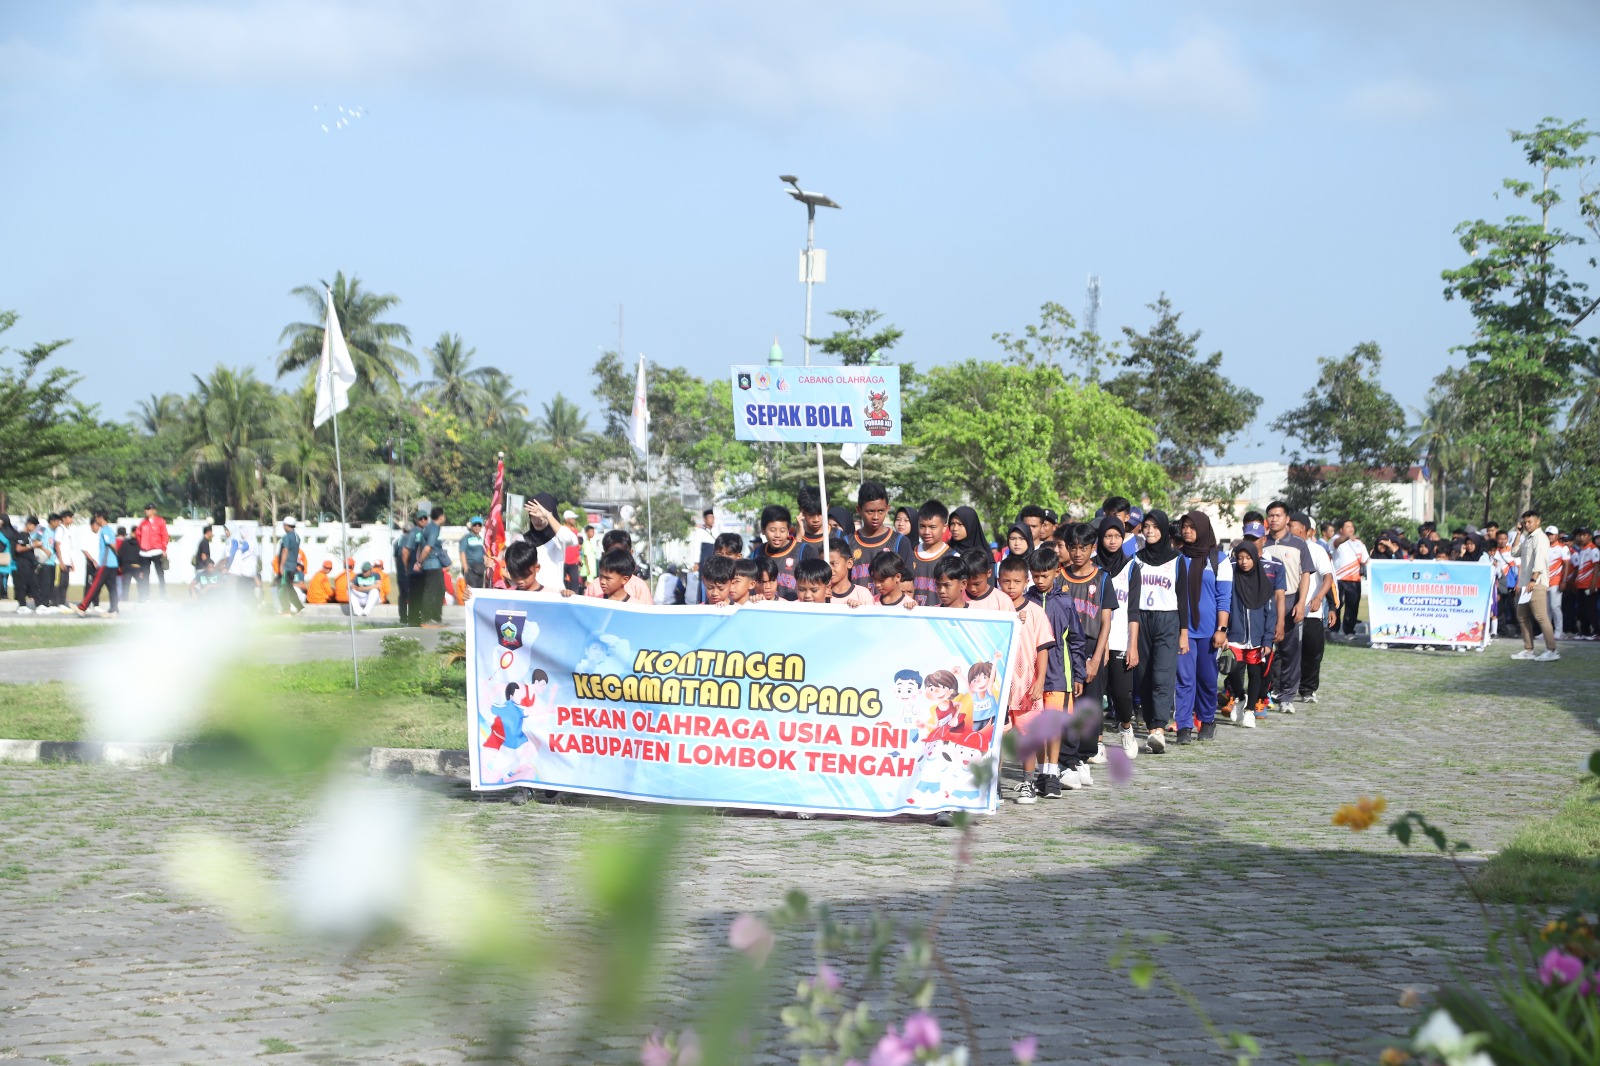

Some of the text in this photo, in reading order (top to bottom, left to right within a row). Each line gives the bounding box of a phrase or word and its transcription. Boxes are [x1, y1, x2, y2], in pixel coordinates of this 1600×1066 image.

[798, 376, 885, 384] CABANG OLAHRAGA
[746, 404, 853, 427] SEPAK BOLA
[1141, 574, 1172, 590] NUMEN
[1384, 583, 1478, 596] PEKAN OLAHRAGA USIA DINI
[1146, 591, 1154, 607] 6
[1403, 596, 1458, 606] KONTINGEN
[633, 648, 805, 682] KONTINGEN
[572, 673, 883, 718] KECAMATAN KOPANG
[557, 706, 908, 749] PEKAN OLAHRAGA USIA DINI
[549, 733, 916, 778] KABUPATEN LOMBOK TENGAH
